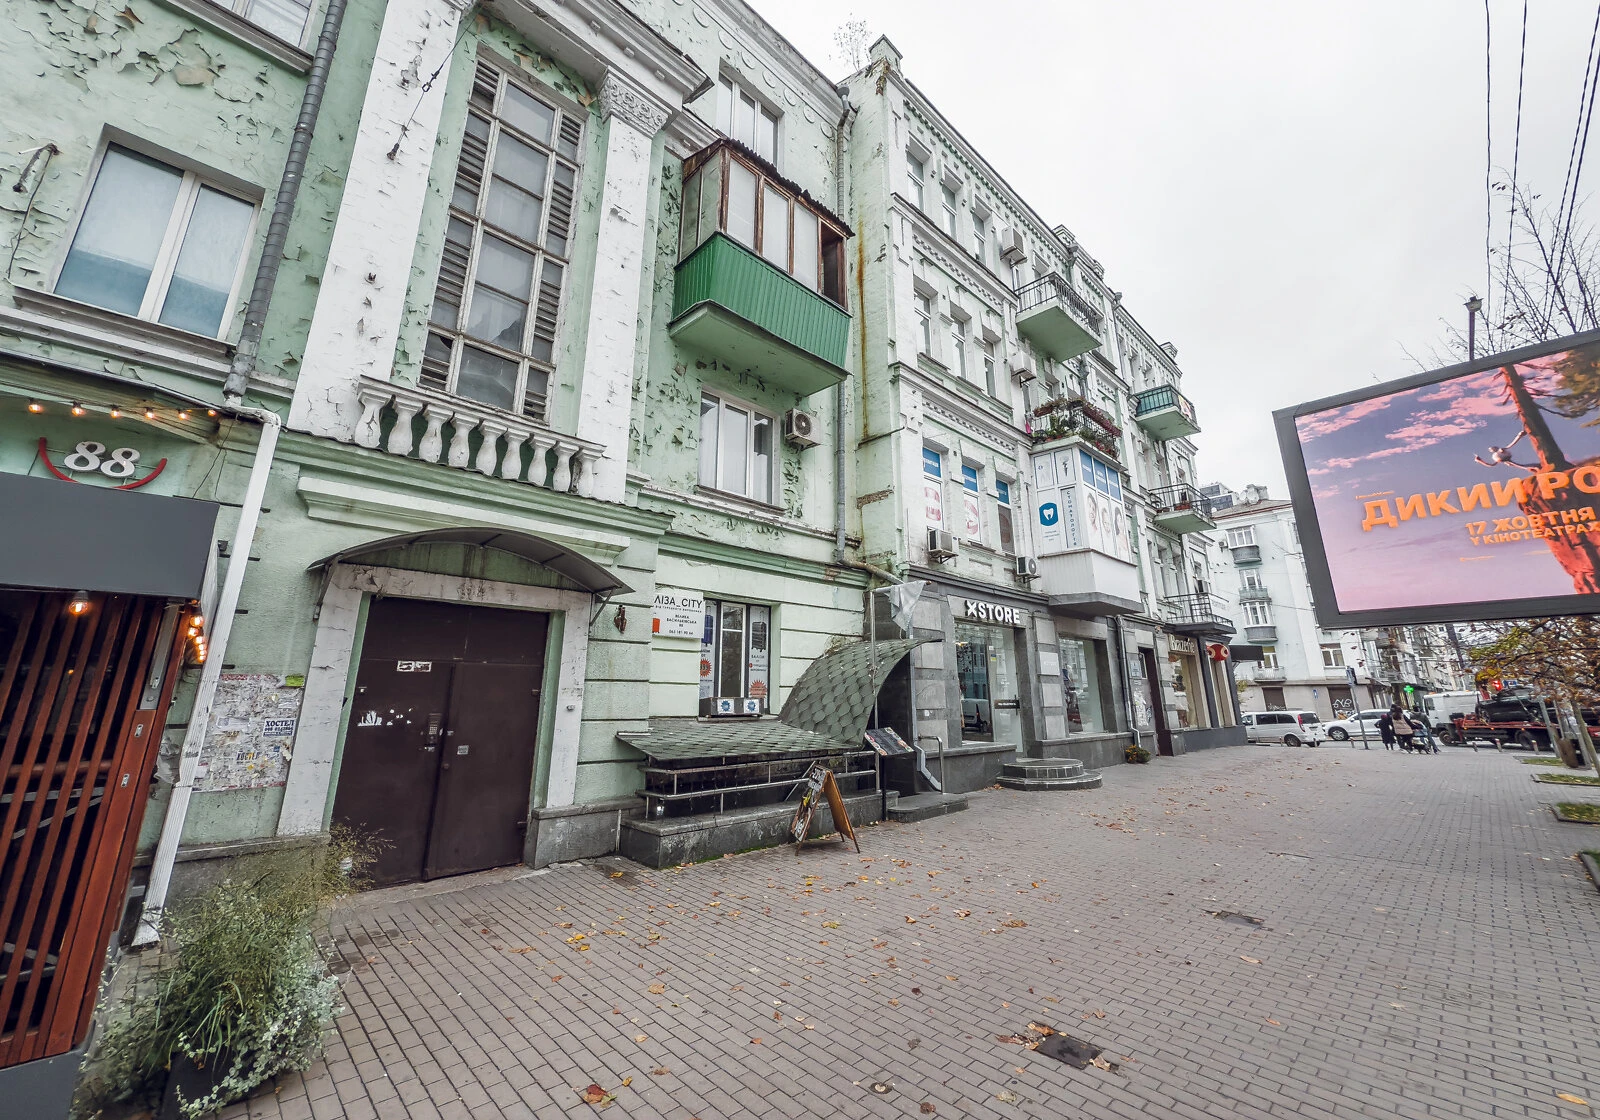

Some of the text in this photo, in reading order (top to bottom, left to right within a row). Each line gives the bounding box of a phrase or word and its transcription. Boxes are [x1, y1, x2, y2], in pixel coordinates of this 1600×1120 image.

[64, 441, 141, 477] 88
[1465, 506, 1597, 536] 17 ЖОВТНЯ
[1469, 521, 1600, 546] У КІНОТЕАТРАХ
[965, 600, 1020, 624] XSTORE
